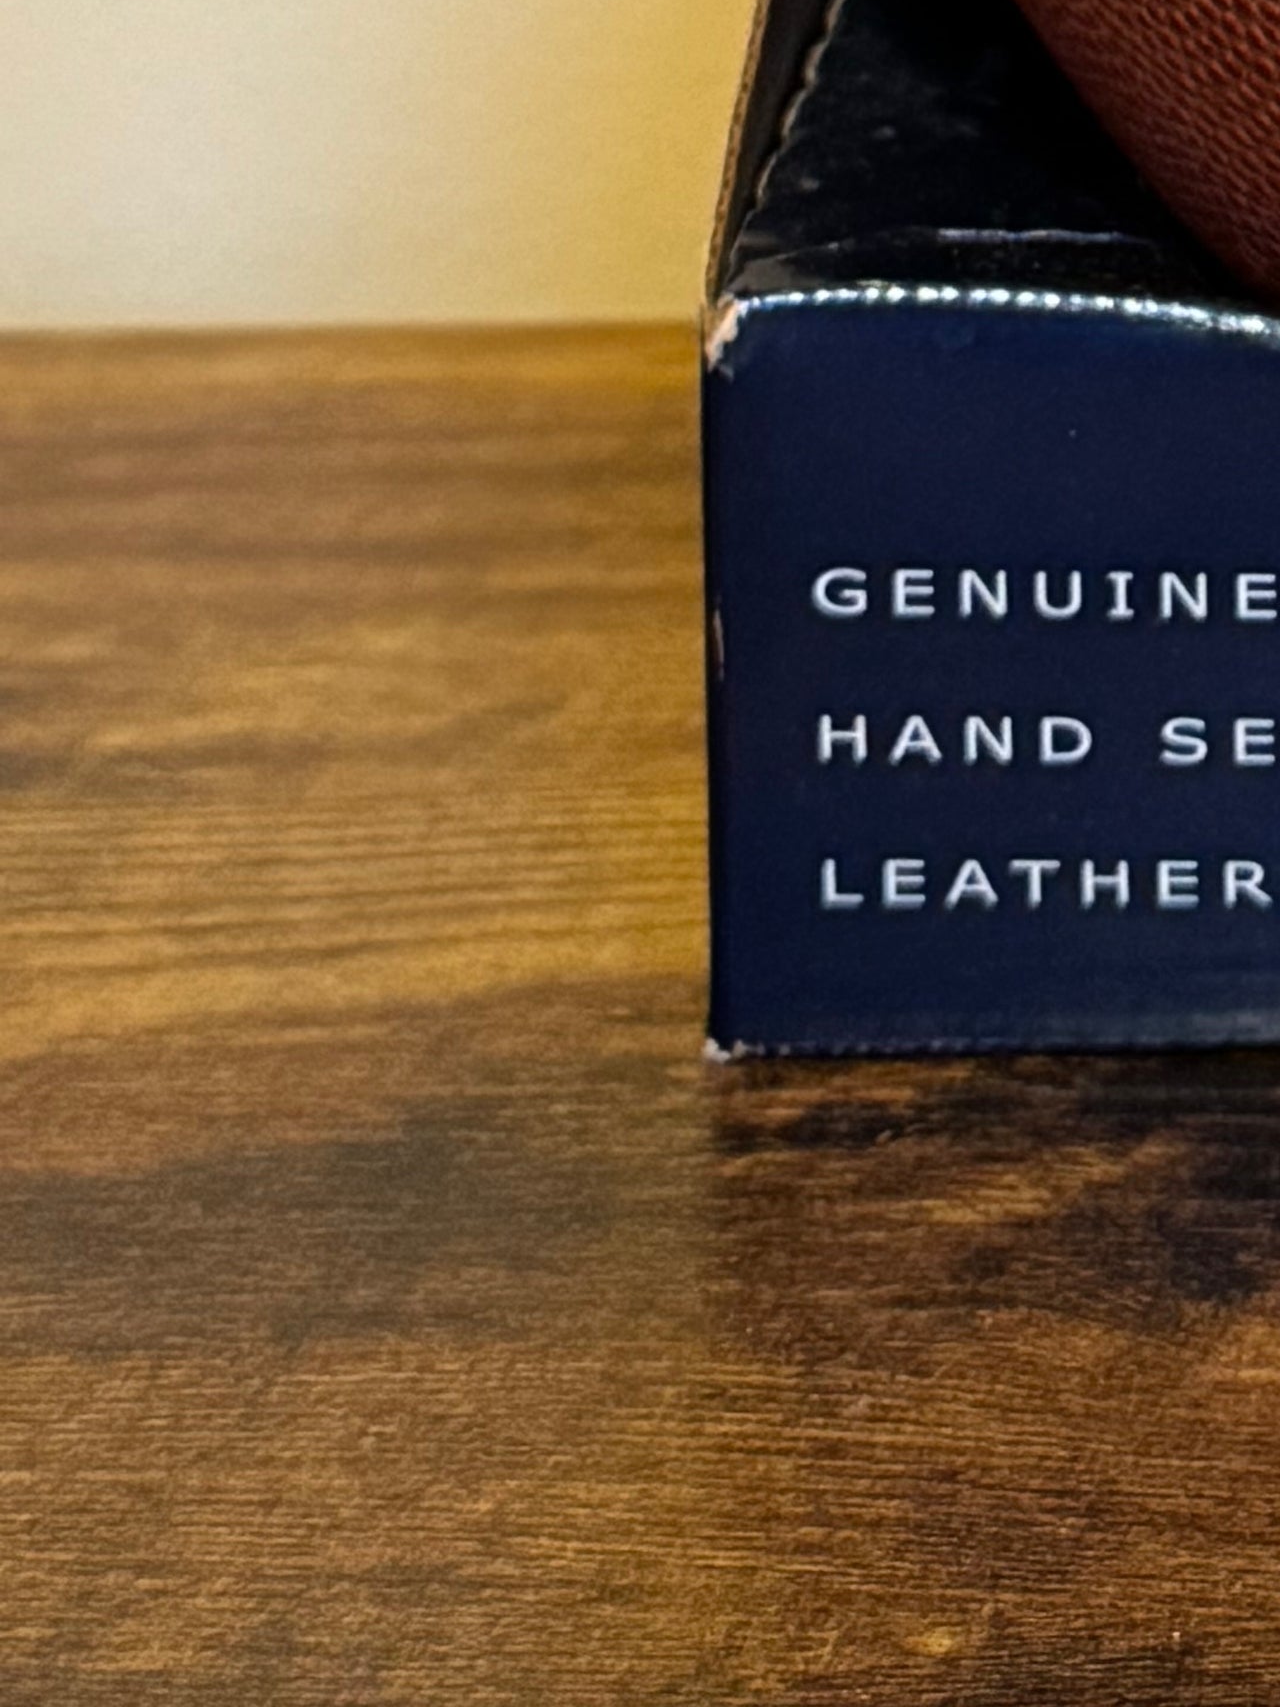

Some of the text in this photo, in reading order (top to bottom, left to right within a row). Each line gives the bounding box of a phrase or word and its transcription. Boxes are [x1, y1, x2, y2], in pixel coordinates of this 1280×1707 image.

[811, 568, 1279, 619] GENUINE
[816, 714, 1093, 765] HAND
[819, 858, 1273, 910] LEATHER
